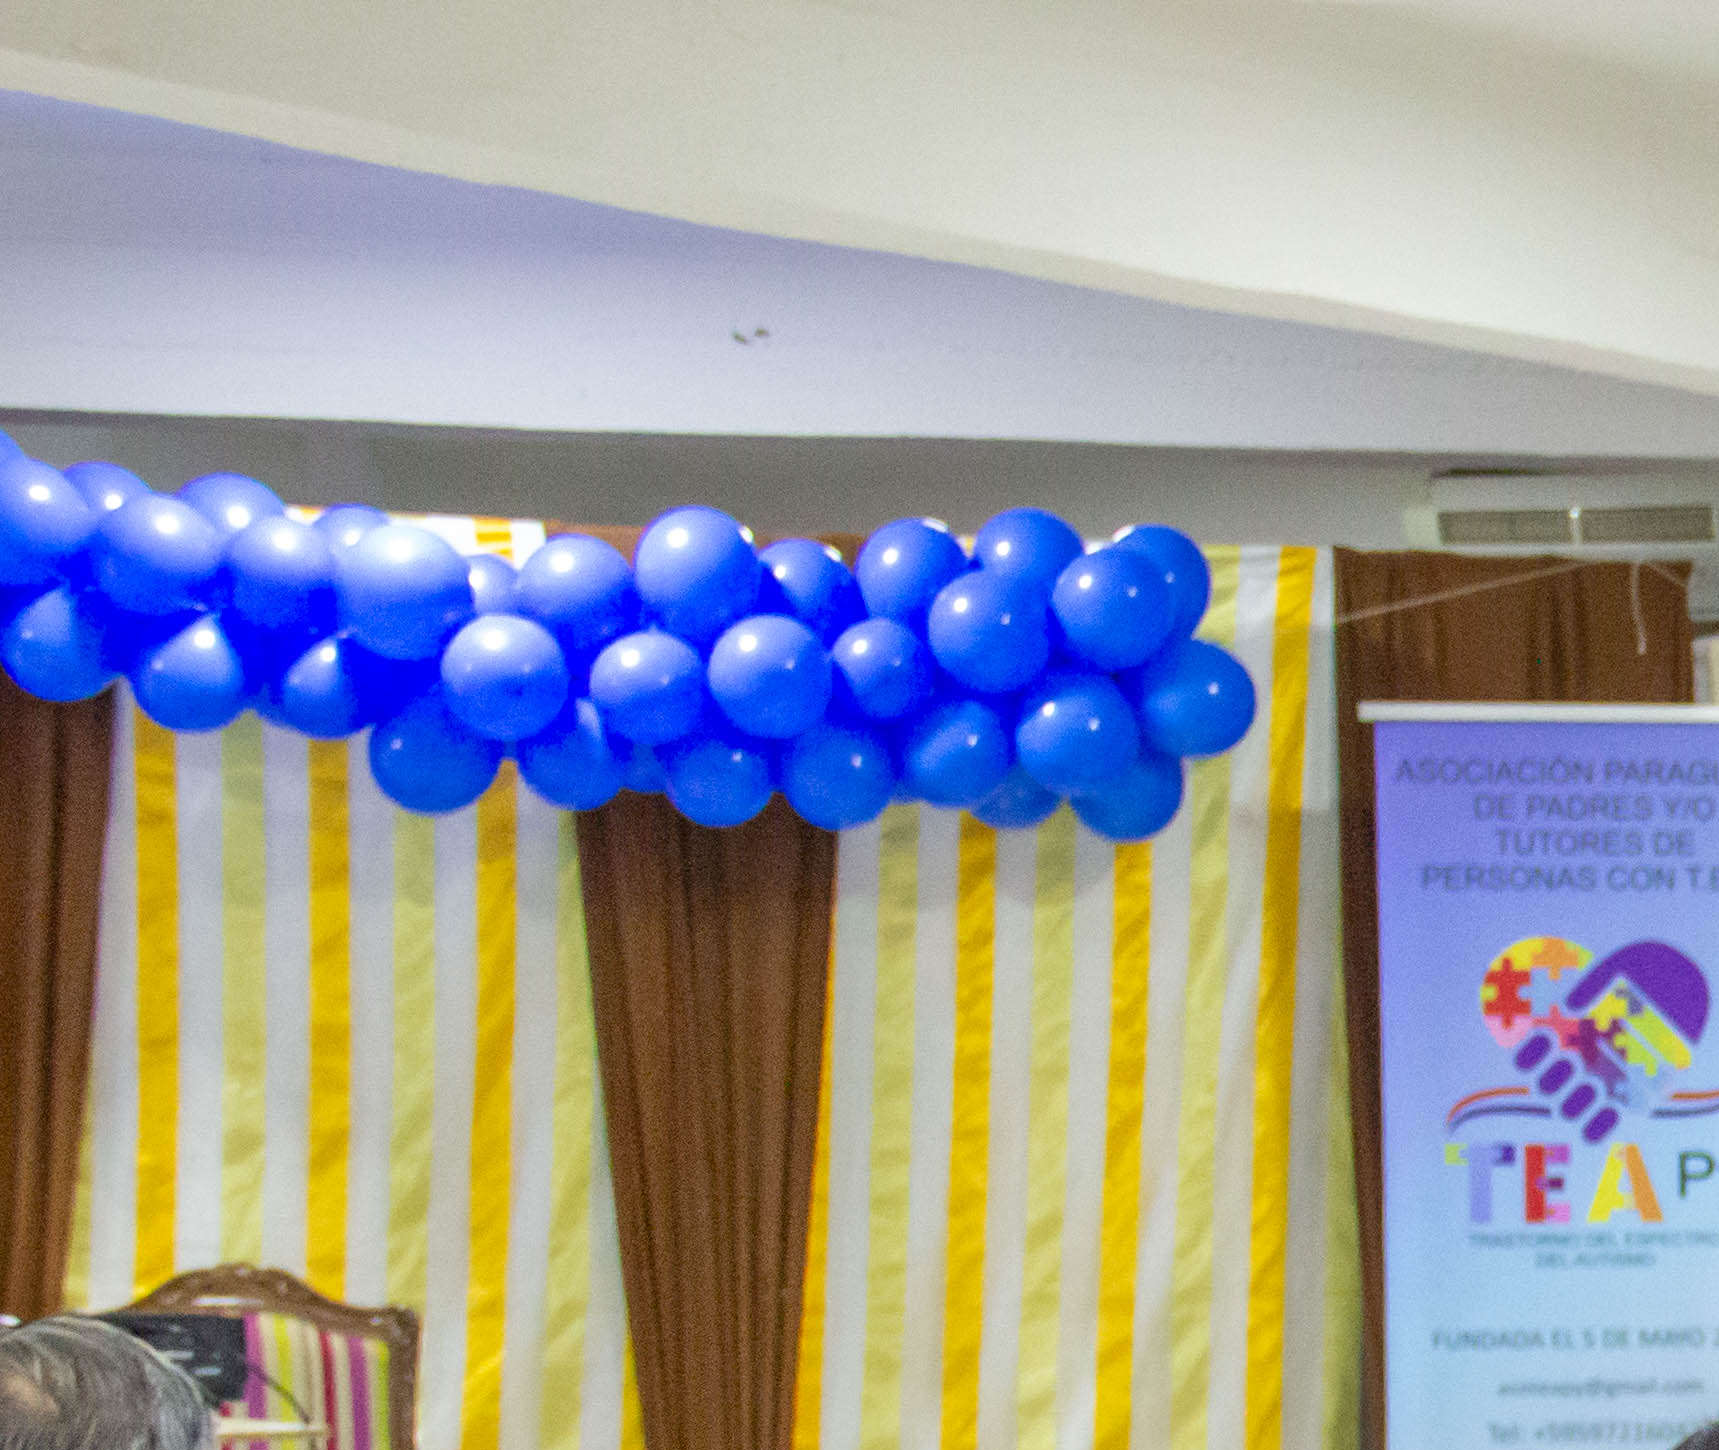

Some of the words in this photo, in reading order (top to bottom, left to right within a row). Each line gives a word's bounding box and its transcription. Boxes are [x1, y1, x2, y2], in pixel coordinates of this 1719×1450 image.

[1396, 755, 1594, 786] ASOCIACIÓN
[1473, 796, 1514, 822] DE
[1527, 796, 1654, 822] PADRES
[1662, 796, 1717, 822] Y/O
[1496, 831, 1644, 857] TUTORES
[1654, 831, 1696, 857] DE
[1422, 865, 1597, 891] PERSONAS
[1606, 865, 1676, 891] CON
[1444, 1143, 1664, 1223] TEA
[1535, 1253, 1569, 1268] DEL
[1431, 1329, 1545, 1350] FUNDADA
[1551, 1329, 1576, 1350] EL
[1602, 1328, 1631, 1349] DE
[1638, 1328, 1706, 1349] MAYO
